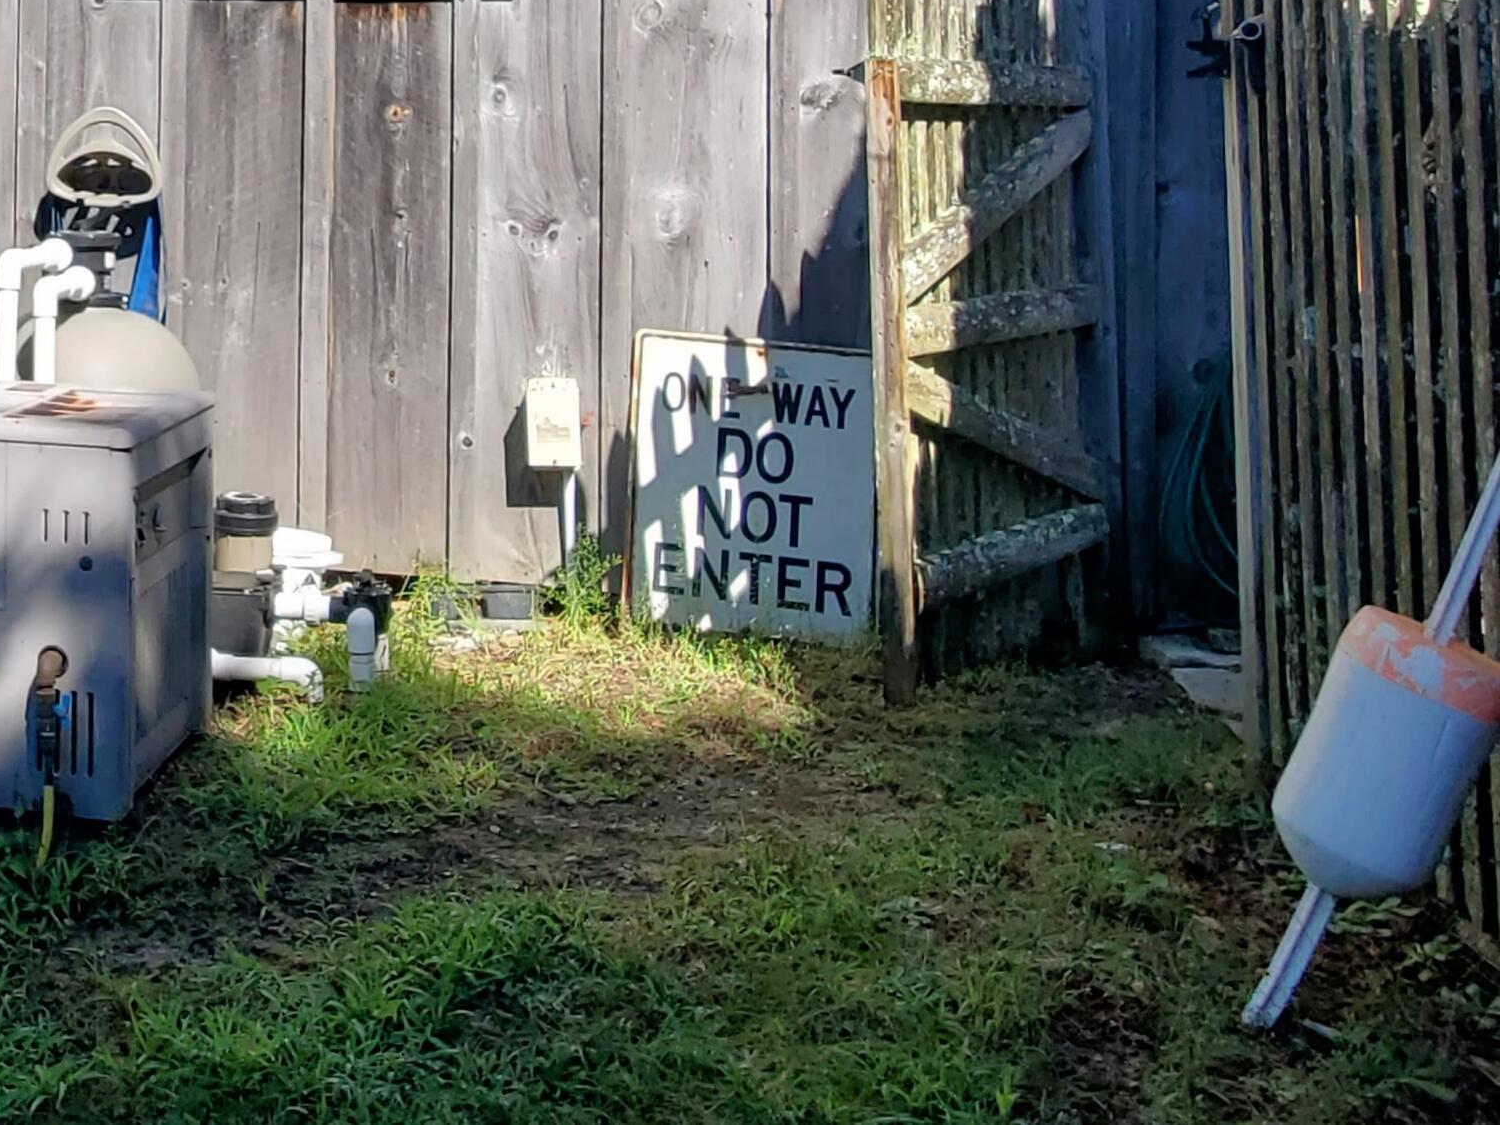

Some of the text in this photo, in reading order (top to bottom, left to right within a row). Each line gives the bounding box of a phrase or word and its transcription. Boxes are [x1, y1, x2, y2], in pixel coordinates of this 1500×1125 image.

[661, 371, 856, 429] ONE WAY
[716, 426, 794, 484] DO
[696, 485, 814, 548] NOT
[652, 541, 852, 617] ENTER
